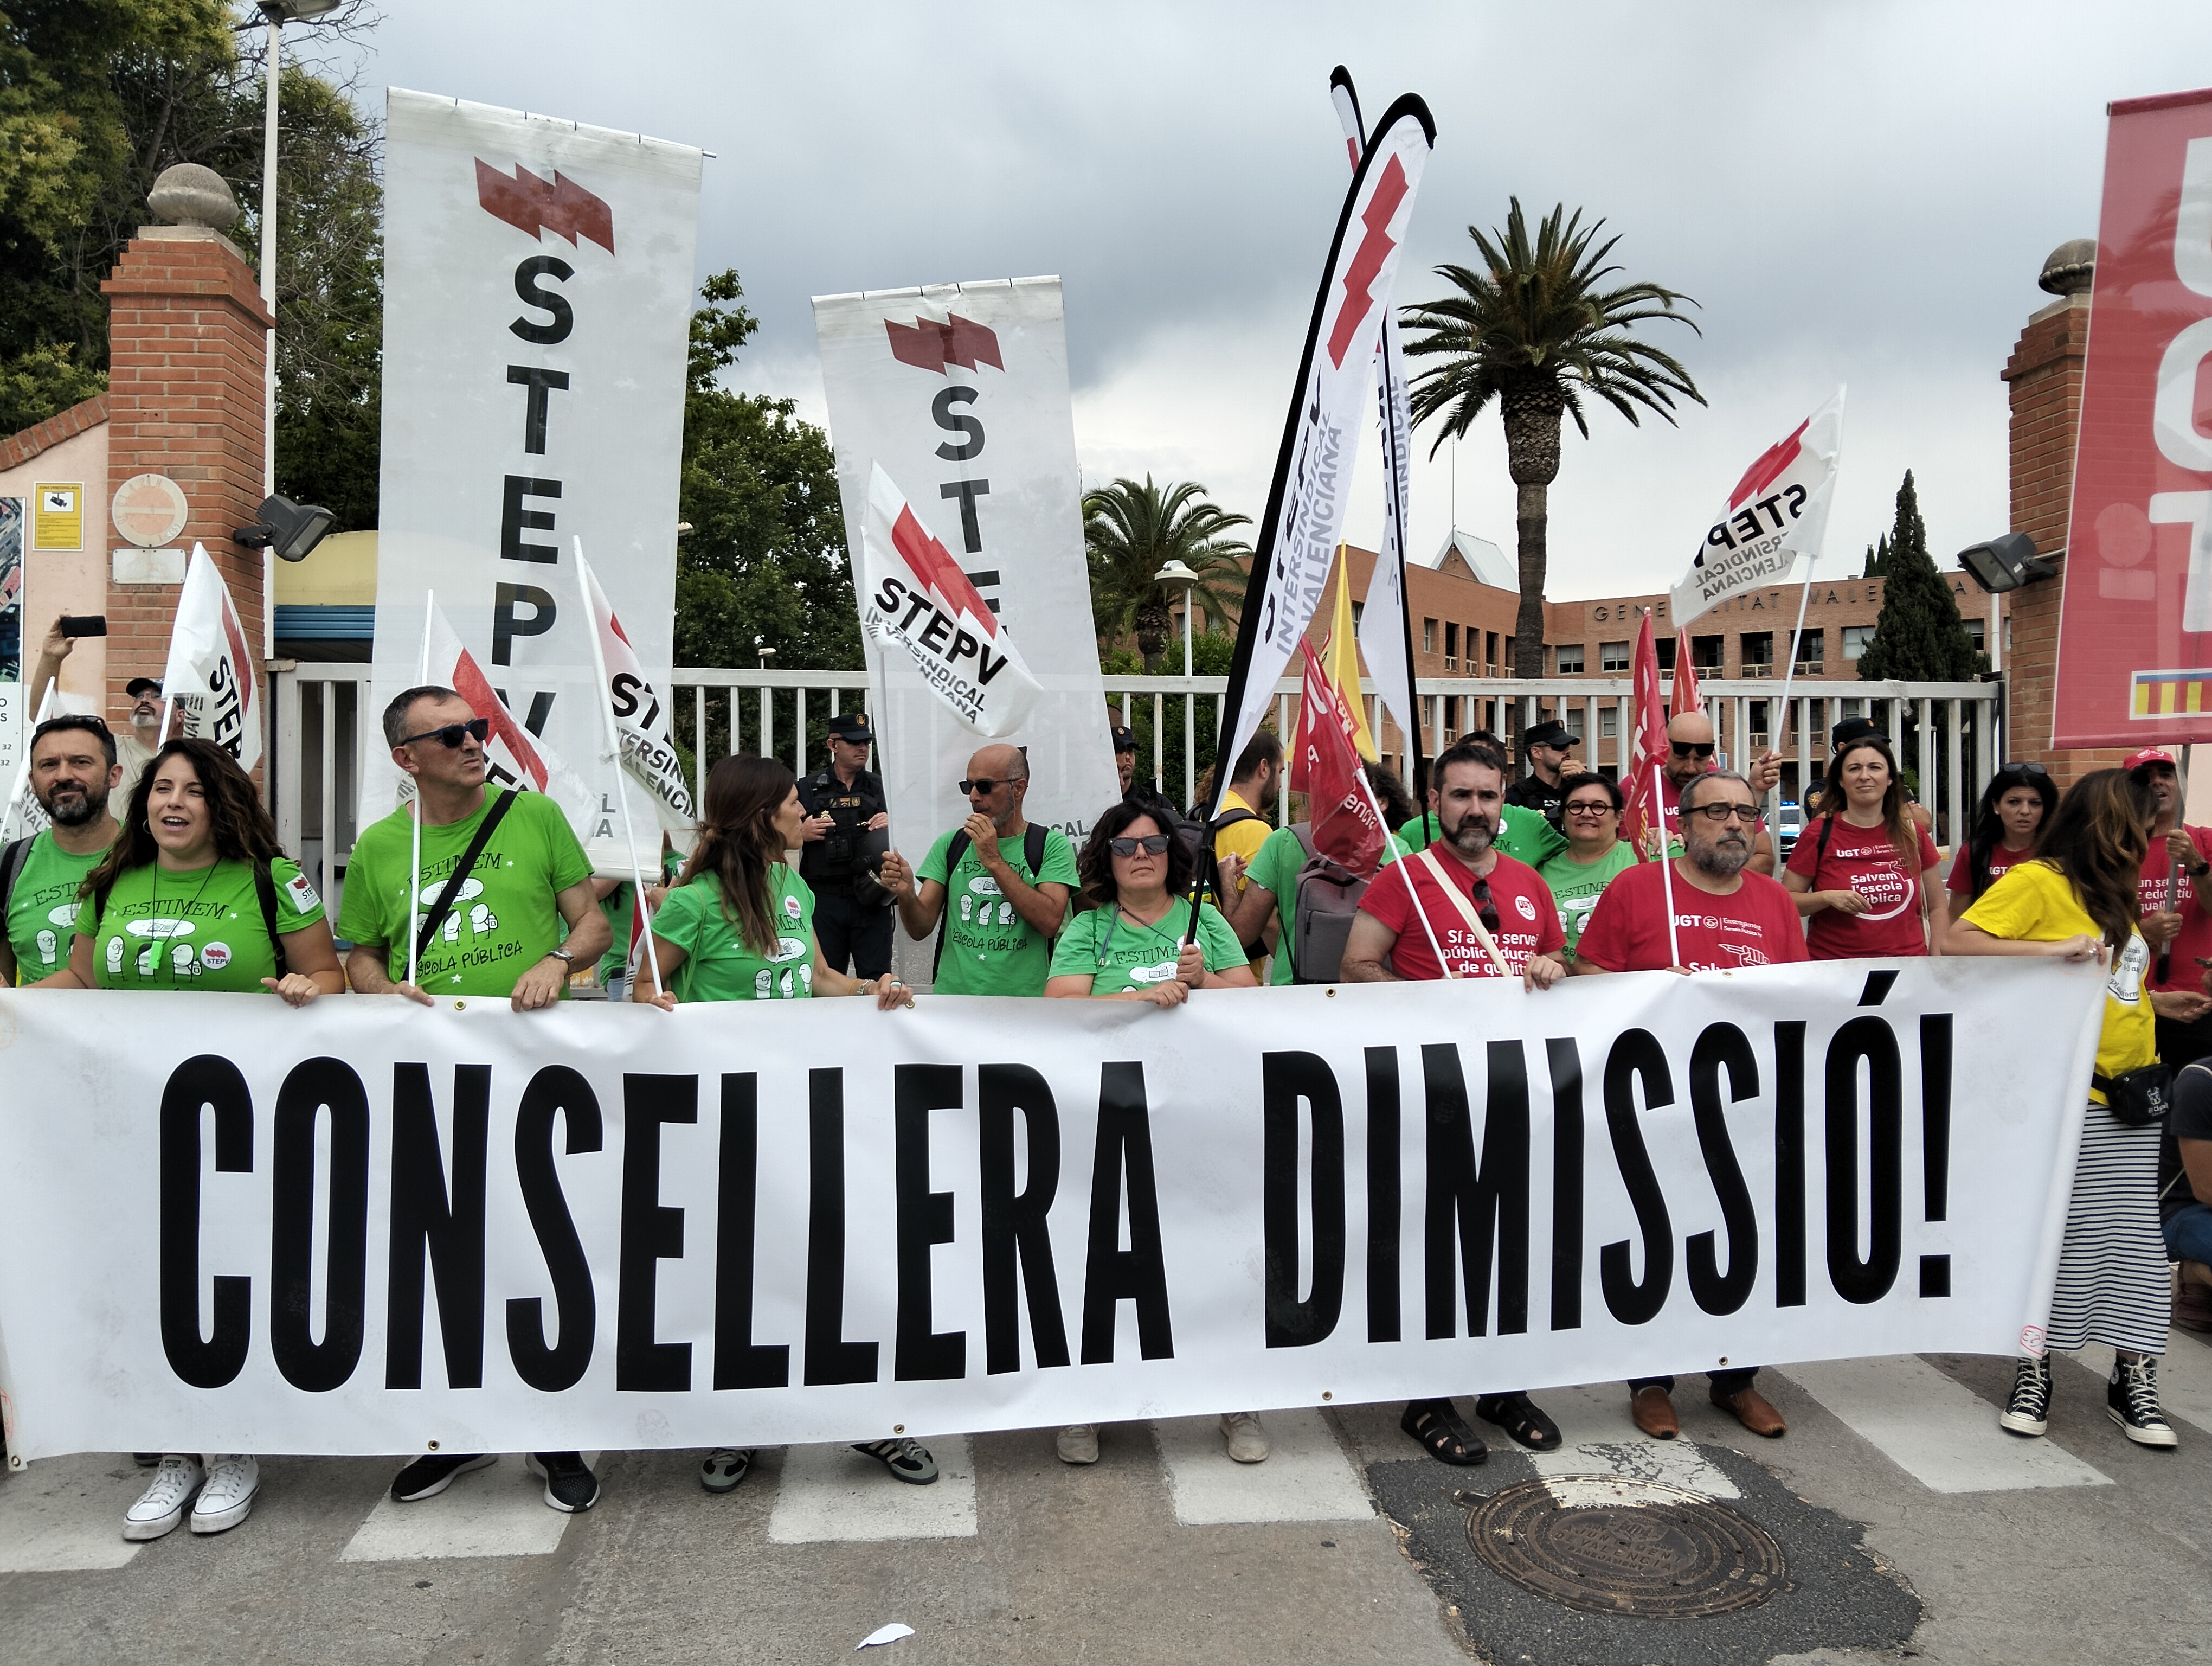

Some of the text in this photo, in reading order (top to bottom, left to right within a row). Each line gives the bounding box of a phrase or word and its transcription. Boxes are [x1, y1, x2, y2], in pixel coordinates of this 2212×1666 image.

[874, 577, 1008, 686] STEPV
[209, 655, 242, 759] STEP
[1665, 806, 1680, 816] UG
[1836, 849, 1860, 857] UGT
[1850, 873, 1898, 884] Salvem
[1553, 881, 1611, 900] ESTIME
[1851, 881, 1903, 894] l'escola
[1864, 893, 1901, 904] ública
[122, 898, 229, 920] ESTIMEM
[1448, 930, 1539, 946] Sí a n servei
[1114, 946, 1180, 965] ESTIME
[1459, 960, 1480, 973] de
[158, 970, 1954, 1393] CONSELLERA DIMISSIÓ!
[1563, 1524, 1682, 1563] AJUNTAMENT
